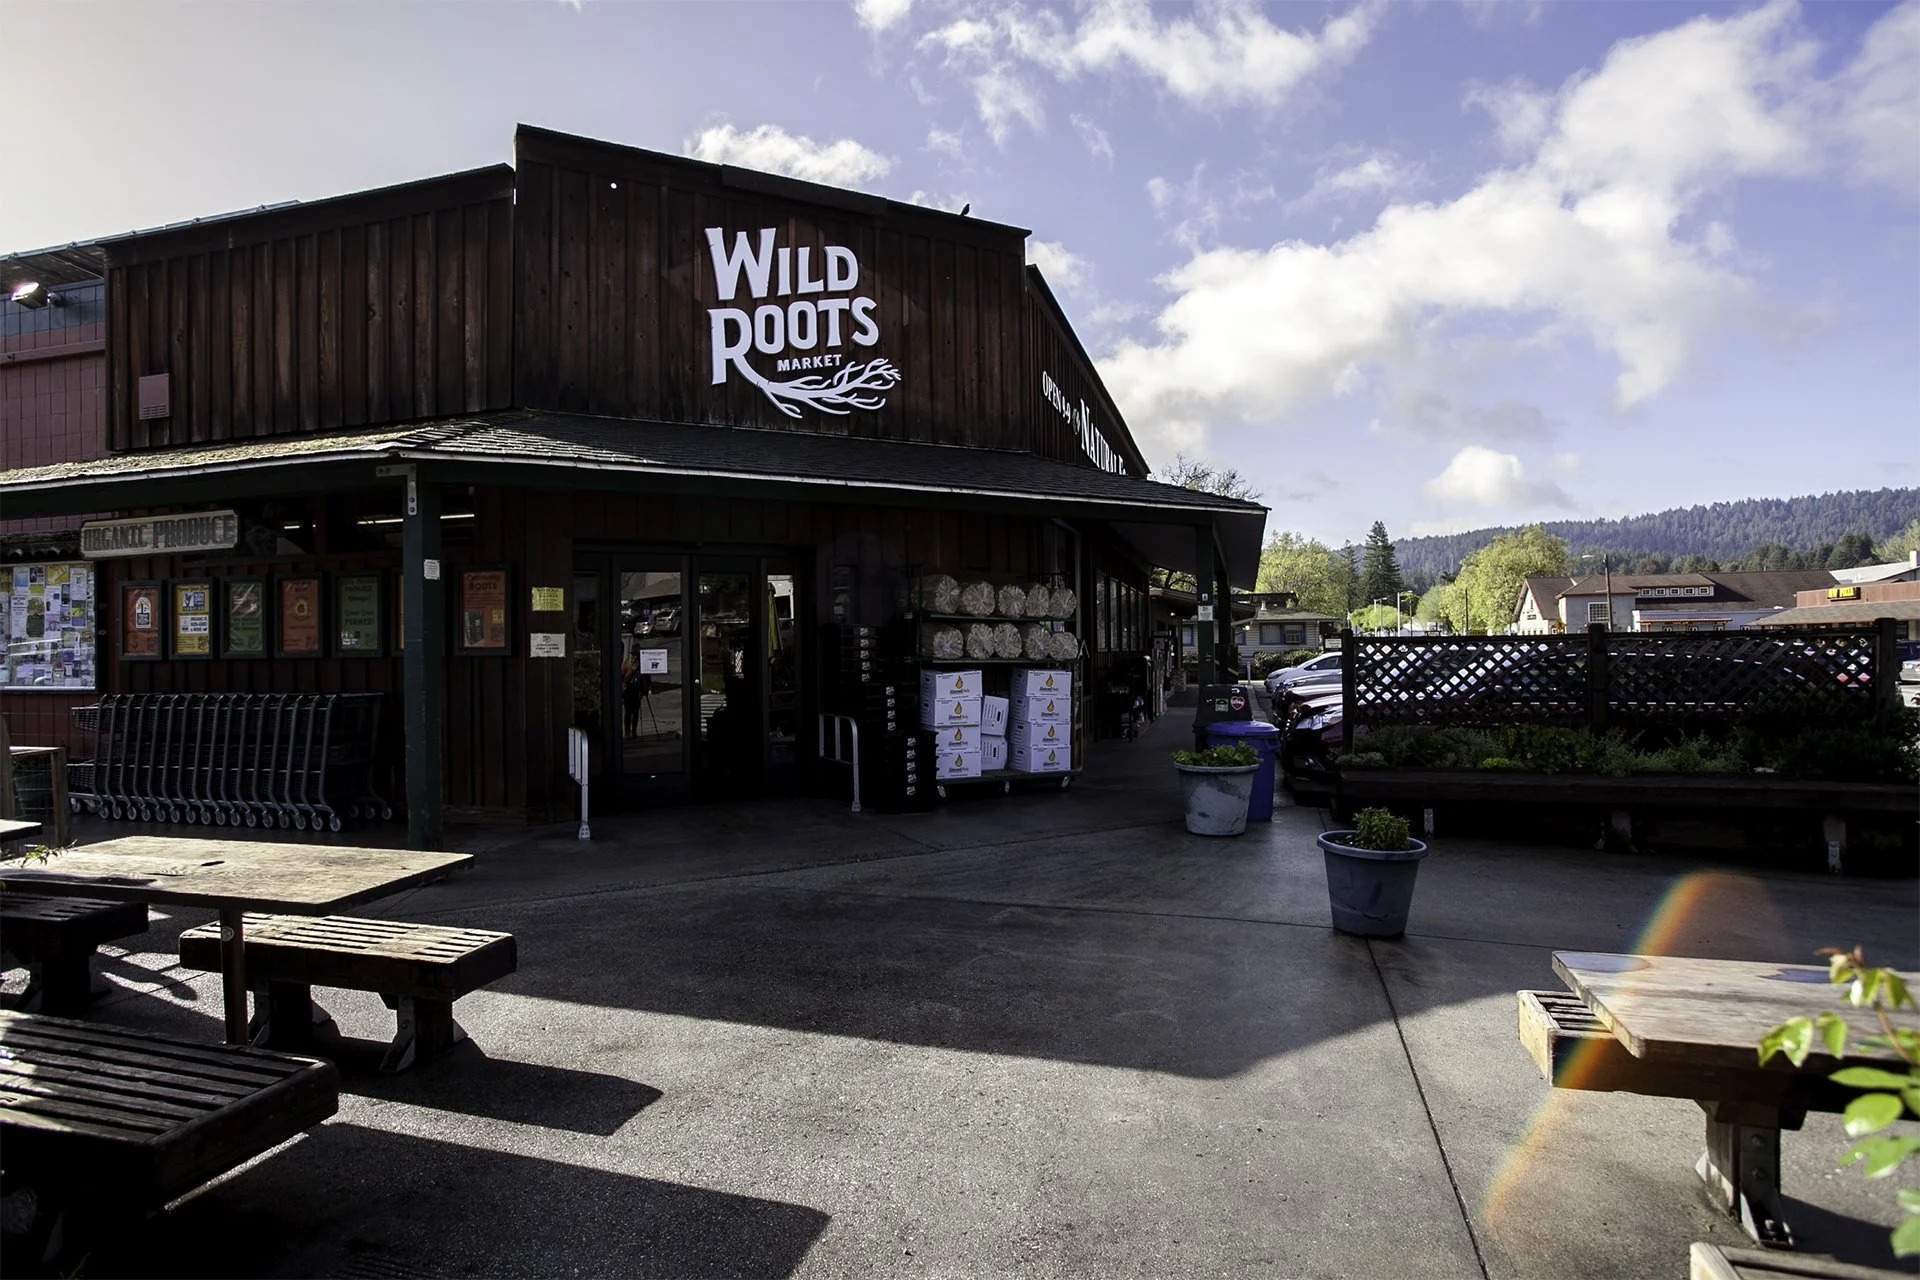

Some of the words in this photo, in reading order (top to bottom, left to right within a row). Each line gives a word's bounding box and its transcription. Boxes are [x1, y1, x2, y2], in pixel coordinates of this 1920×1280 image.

[704, 226, 859, 301] WILD
[706, 296, 881, 387] ROOTS
[776, 354, 842, 372] MARKET
[1042, 370, 1062, 414] OPEN
[83, 525, 148, 551] ORGANIC
[152, 516, 236, 548] PRODUCE
[470, 582, 497, 591] ROOTS
